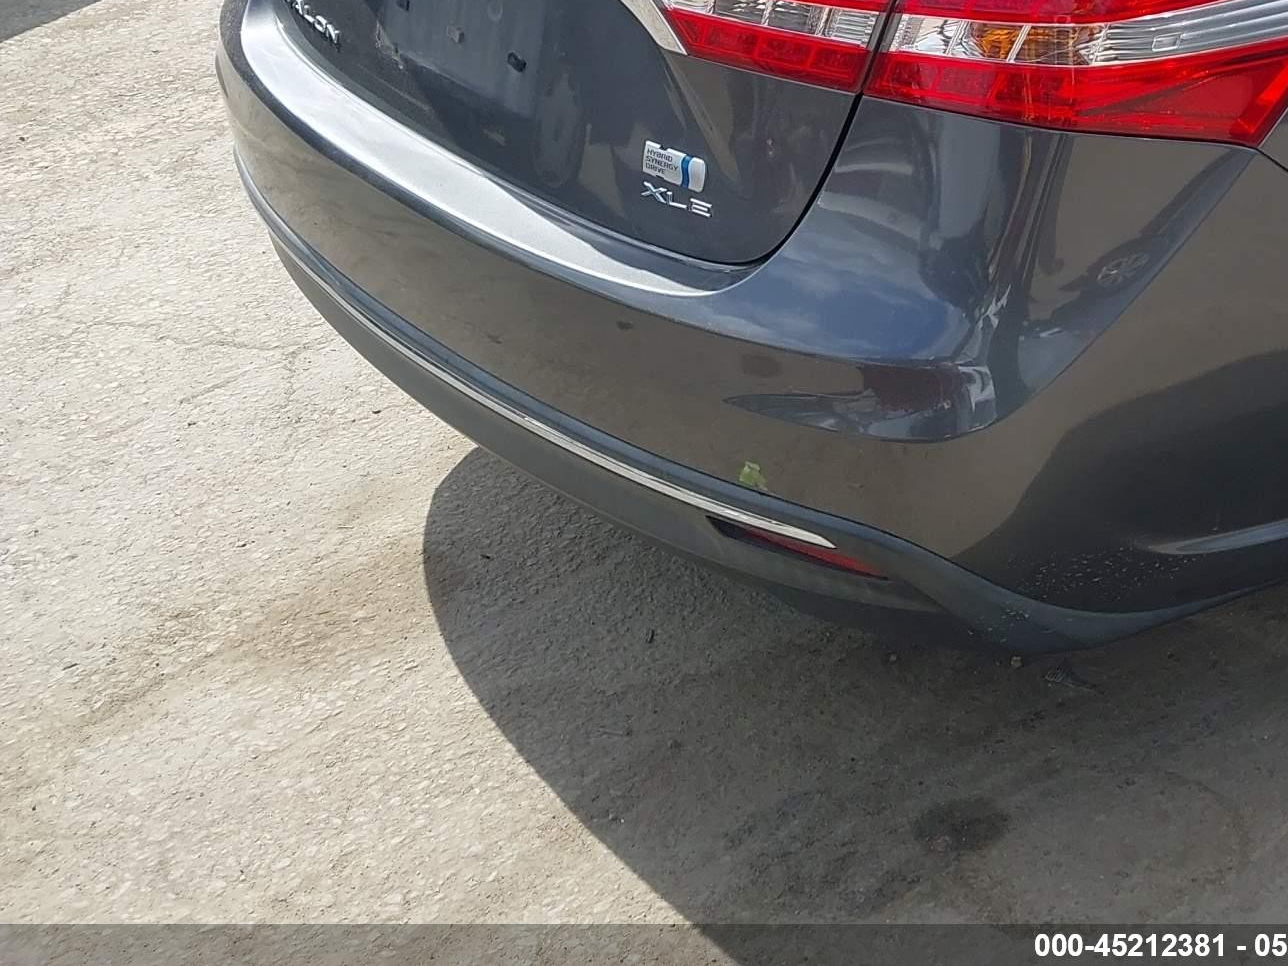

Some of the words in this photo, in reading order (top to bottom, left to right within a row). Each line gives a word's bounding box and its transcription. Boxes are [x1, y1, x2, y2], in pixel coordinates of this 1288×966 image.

[646, 147, 673, 163] HYBRID
[645, 155, 679, 172] SYNERGY
[645, 162, 666, 175] DRIVE
[640, 180, 713, 218] XLE
